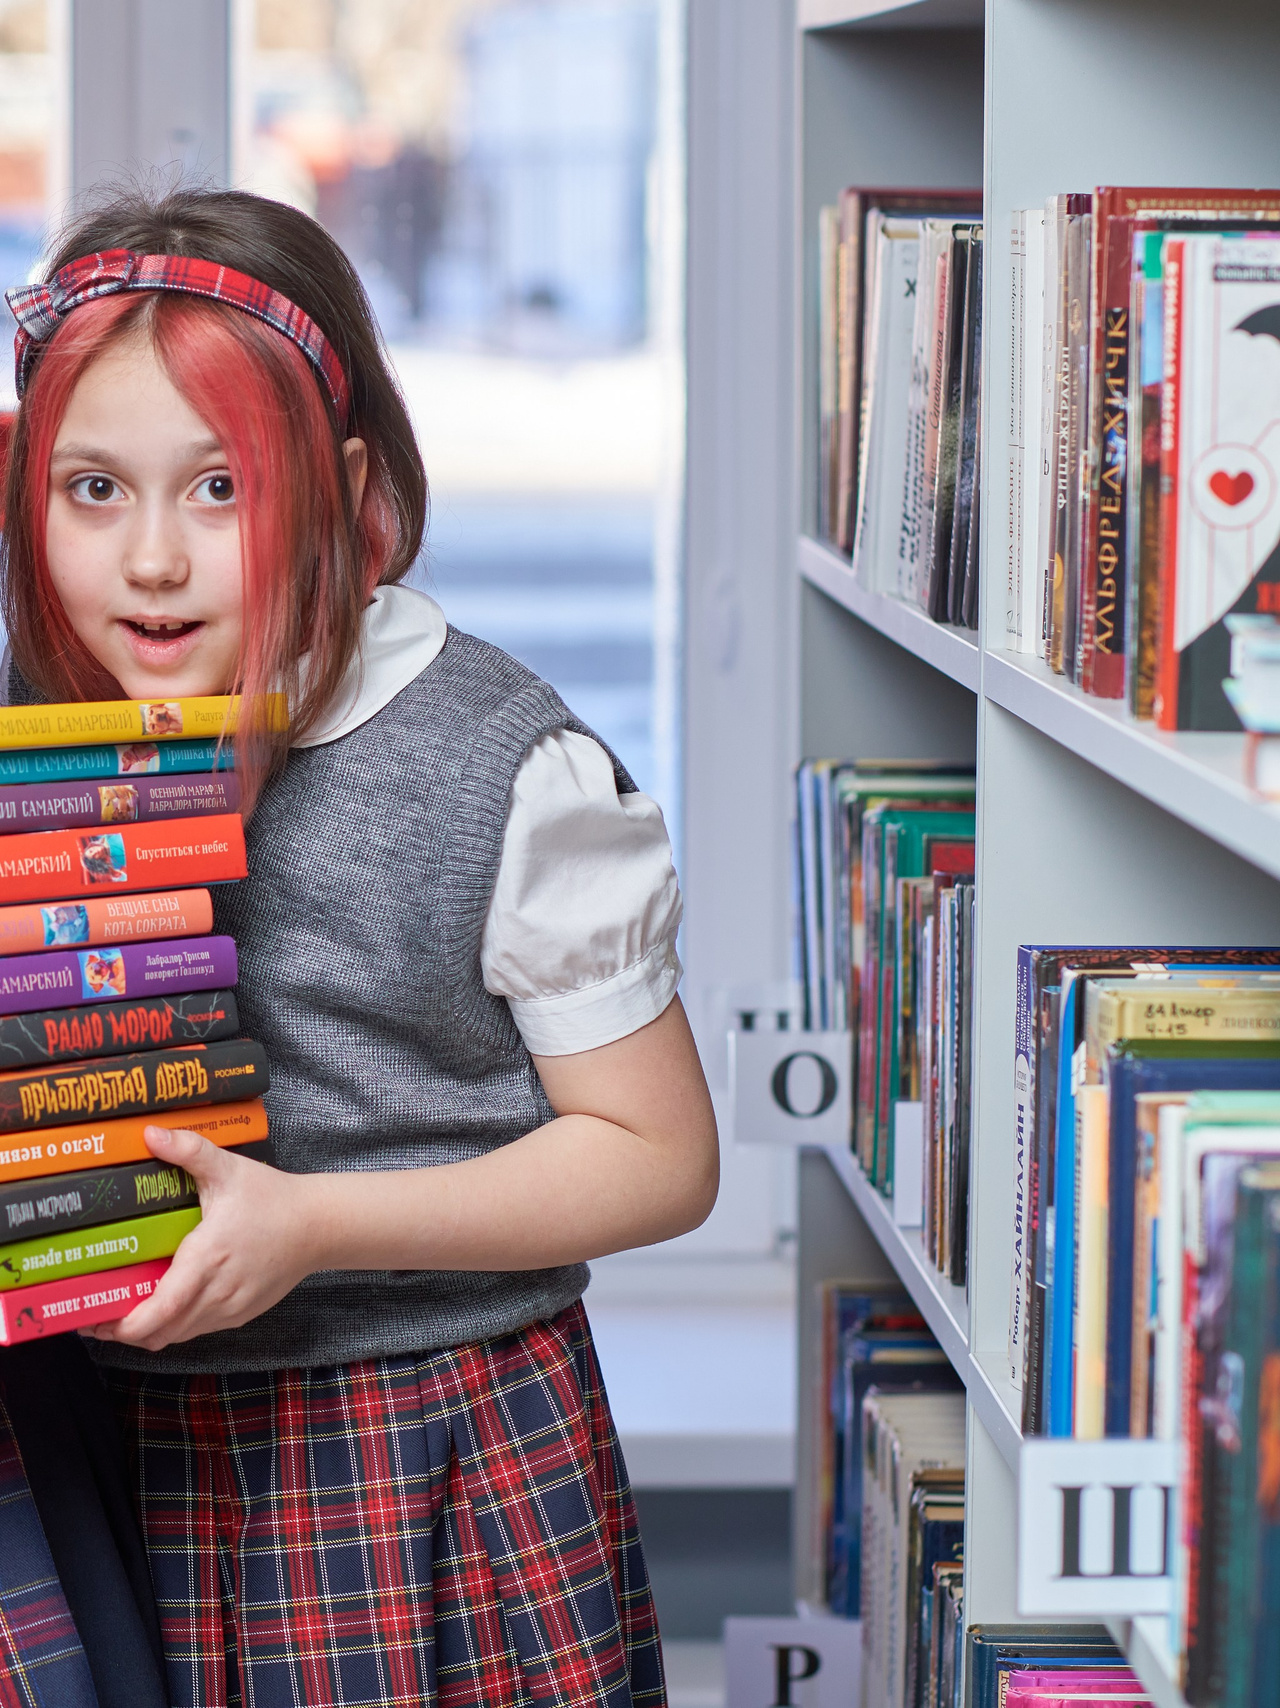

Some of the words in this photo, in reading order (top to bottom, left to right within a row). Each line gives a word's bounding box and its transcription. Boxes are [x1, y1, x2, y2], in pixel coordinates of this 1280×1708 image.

[1093, 464, 1123, 655] АЛЬФРЕД
[0, 713, 52, 736] МИХАИЛ
[57, 709, 133, 732] САМАРСКИЙ
[194, 710, 224, 724] Радуга
[35, 749, 110, 773] САМАРСКИЙ
[166, 747, 204, 765] Тришка
[21, 791, 94, 817] САМАРСКИЙ
[149, 785, 186, 800] ОСЕННИЙ
[187, 784, 225, 797] МАРАФОН
[148, 798, 193, 813] ЛАБРАДОРА
[193, 796, 228, 810] ТРИСОНА
[135, 845, 193, 862] Спуститься
[194, 845, 201, 854] с
[201, 841, 229, 854] небес
[106, 900, 152, 918] ВЕЩИЕ
[153, 897, 181, 912] СНЫ
[104, 920, 139, 938] КОТА
[139, 916, 187, 936] СОКРАТА
[146, 954, 183, 967] Лабрадор
[183, 951, 210, 962] Трисон
[144, 968, 179, 982] покоряет
[179, 963, 215, 978] Голливуд
[42, 1012, 105, 1057] РАДИО
[106, 1004, 174, 1047] МОРОК
[18, 1061, 148, 1123] ПРИОТКРЫТАЯ
[154, 1056, 209, 1103] ДВЕРЬ
[214, 1066, 246, 1079] РОСМЭН
[771, 1050, 839, 1119] О
[219, 1115, 252, 1129] Фрауке
[47, 1143, 58, 1157] о
[61, 1132, 106, 1156] Дело
[5, 1201, 36, 1229] ТАТЬЯНА
[37, 1191, 83, 1221] МАСТРЮКОВА
[134, 1167, 181, 1206] КОШАЧЬЯ
[1013, 1103, 1026, 1281] ХАЙНЛАЙН
[65, 1246, 82, 1261] на
[86, 1235, 139, 1259] Сыщик
[22, 1248, 62, 1272] арене
[83, 1285, 132, 1310] мягких
[135, 1280, 152, 1296] на
[42, 1296, 81, 1319] лапах
[1012, 1285, 1021, 1346] Роберт
[769, 1643, 823, 1708] Р
